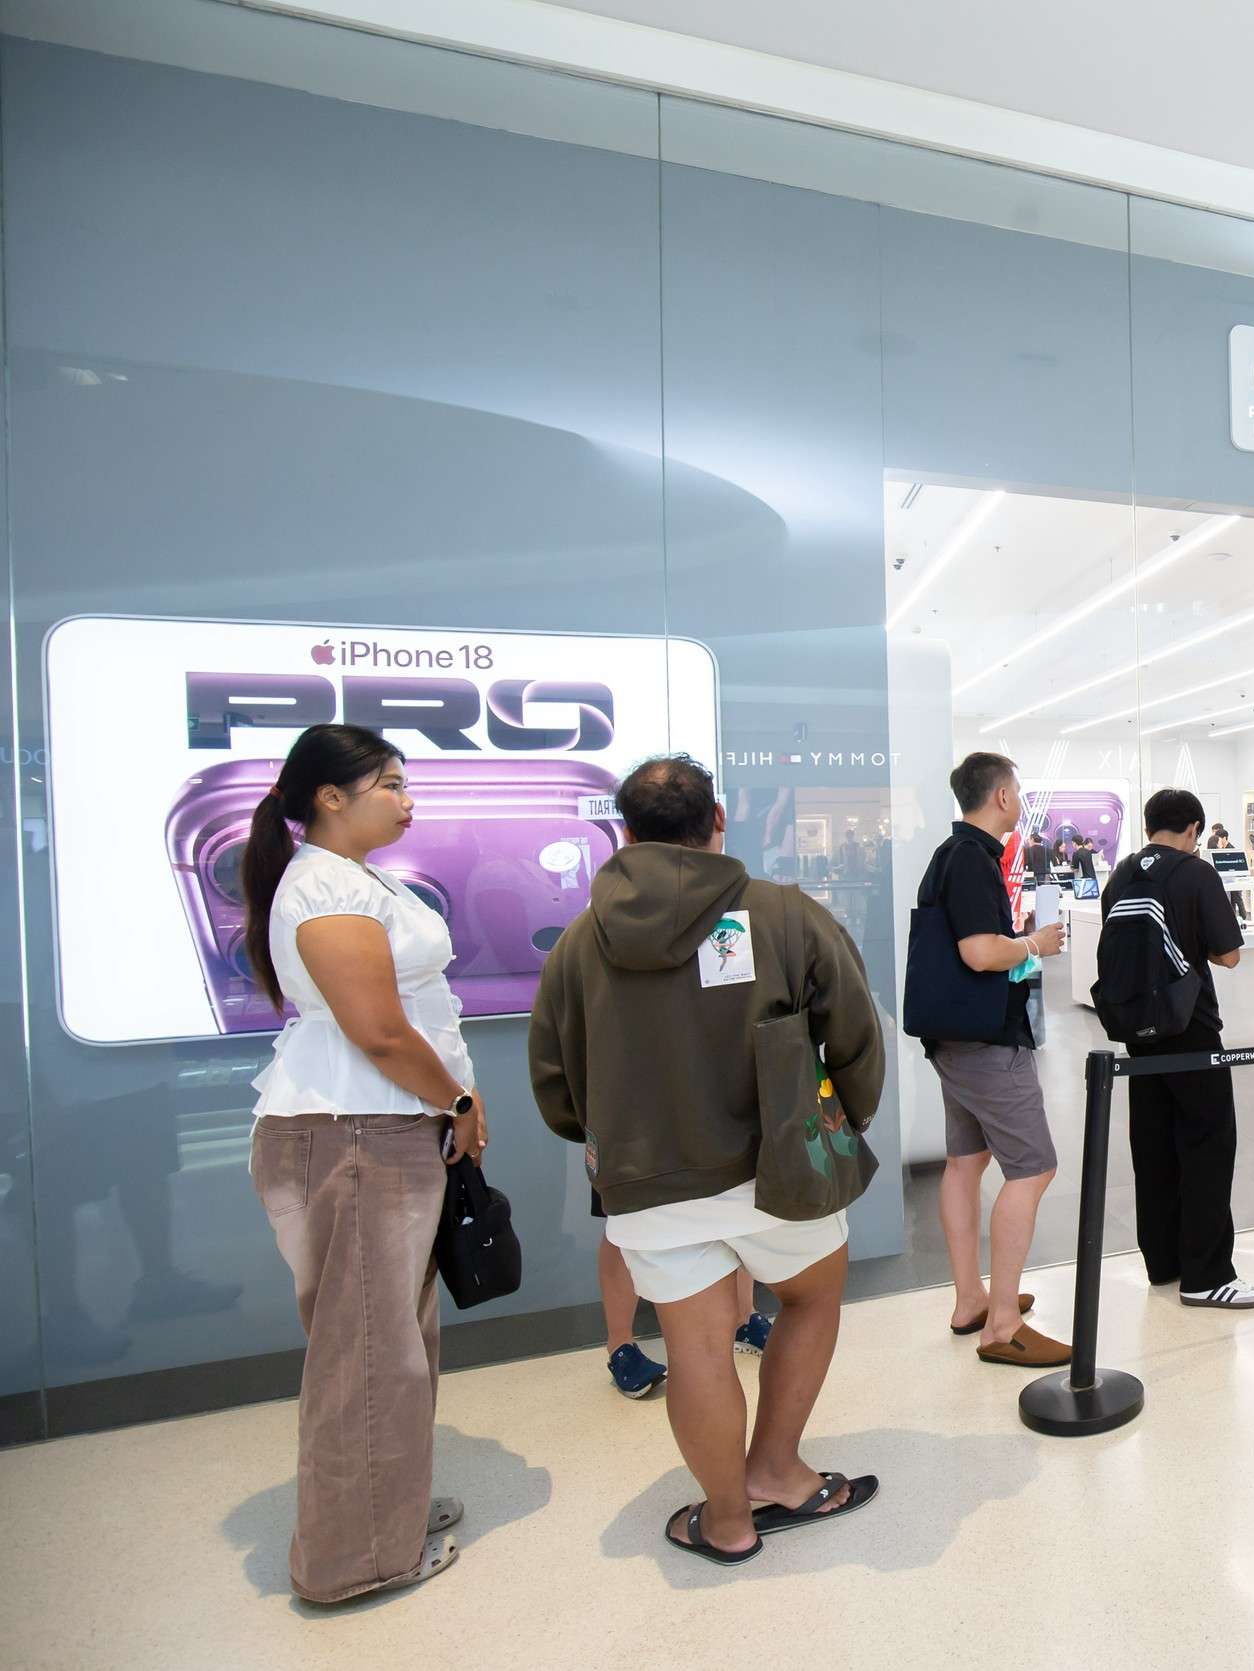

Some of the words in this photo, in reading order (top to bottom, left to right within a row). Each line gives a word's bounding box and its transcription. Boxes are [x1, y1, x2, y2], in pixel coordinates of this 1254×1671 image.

[340, 640, 454, 669] iPhone
[459, 644, 494, 670] 18
[185, 671, 615, 751] PRO
